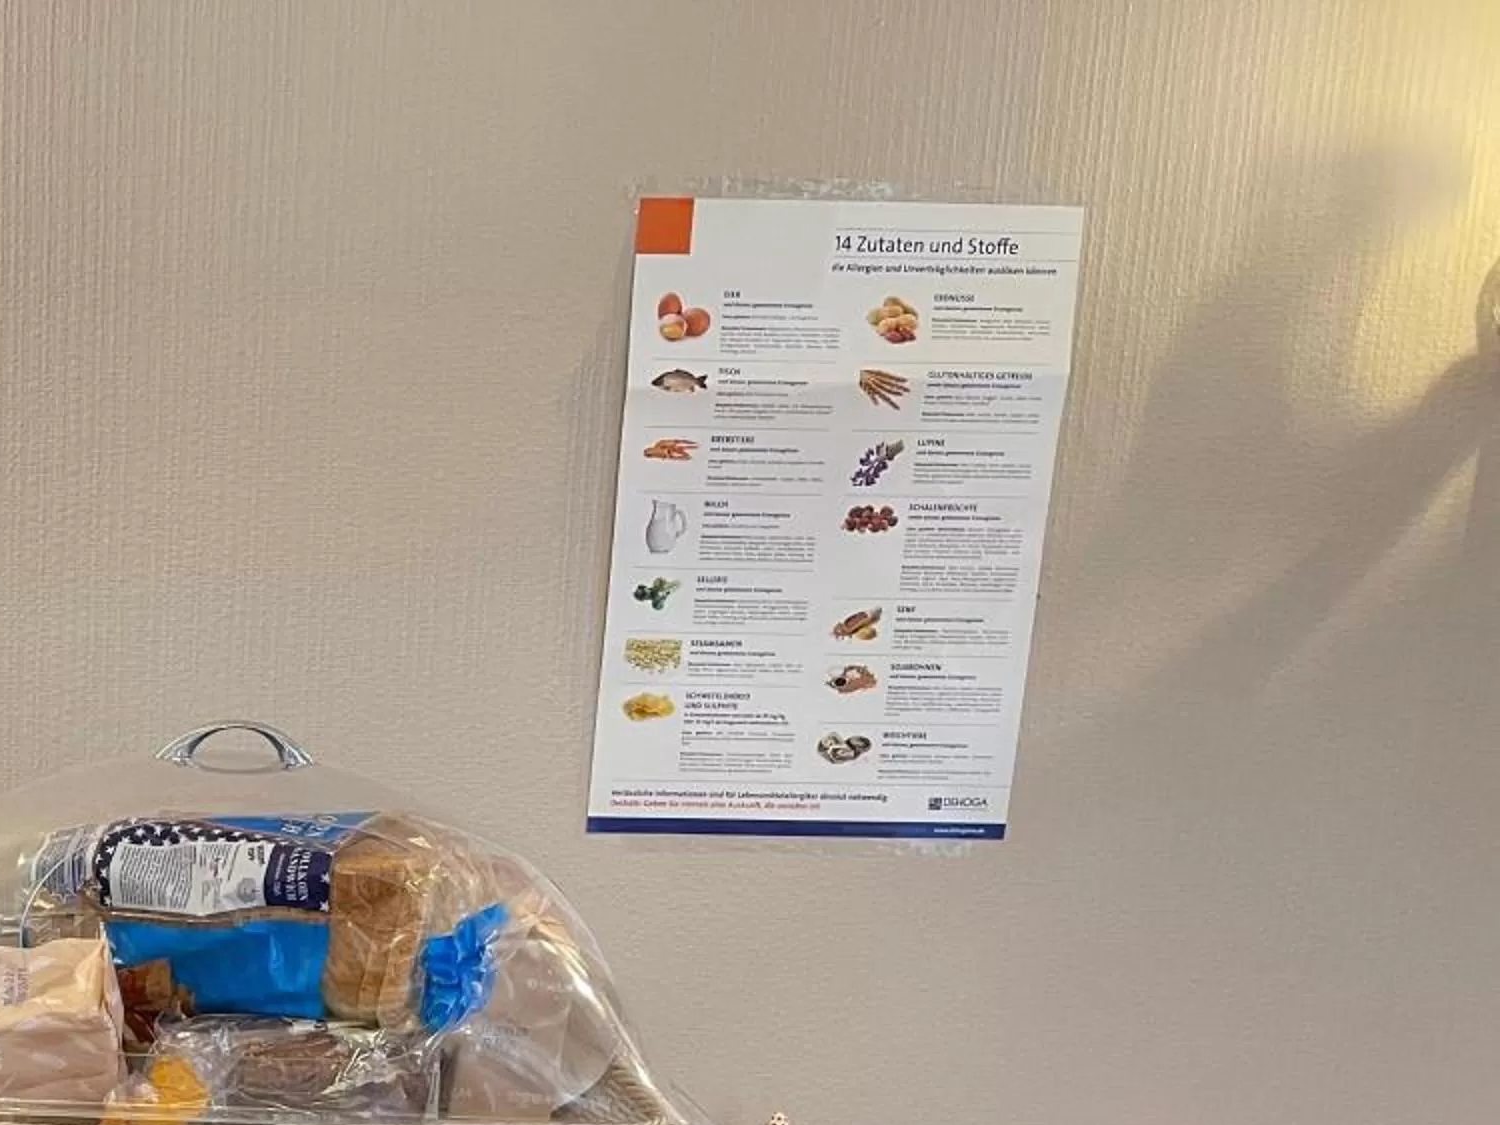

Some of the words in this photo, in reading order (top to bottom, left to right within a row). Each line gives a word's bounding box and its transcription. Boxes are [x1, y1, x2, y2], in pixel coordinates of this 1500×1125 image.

[835, 235, 852, 251] 14
[857, 235, 925, 253] Zutaten
[929, 237, 963, 254] und
[967, 237, 1019, 255] Stoffe
[831, 263, 845, 273] die
[846, 264, 883, 275] Allergien
[885, 264, 902, 273] und
